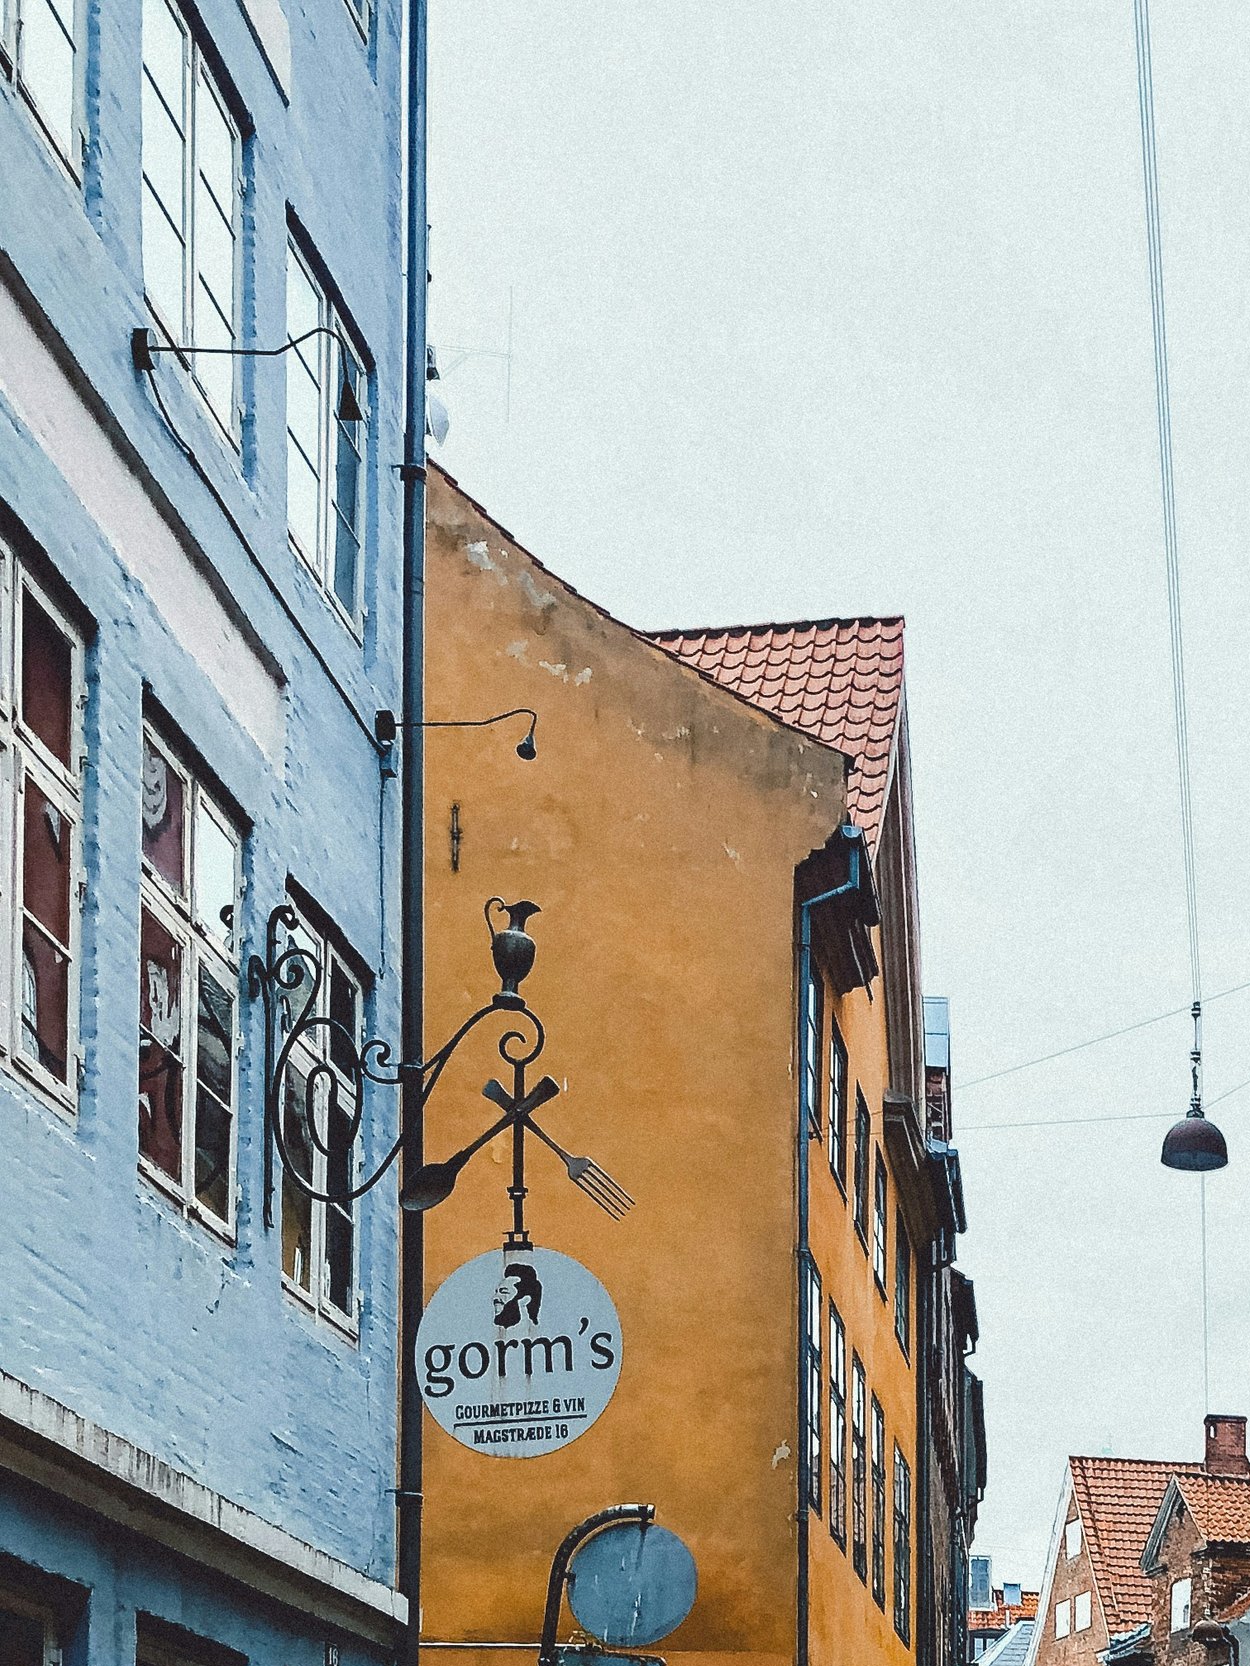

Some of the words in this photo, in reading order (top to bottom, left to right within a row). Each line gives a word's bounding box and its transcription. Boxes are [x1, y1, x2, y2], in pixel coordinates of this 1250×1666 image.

[424, 1317, 615, 1398] gorm's
[455, 1400, 549, 1420] GOURMETPIZZE
[552, 1398, 561, 1413] &
[563, 1397, 585, 1412] VIN
[473, 1425, 552, 1444] MAGSTRÆDE
[555, 1424, 569, 1439] 16
[328, 1647, 339, 1666] 16
